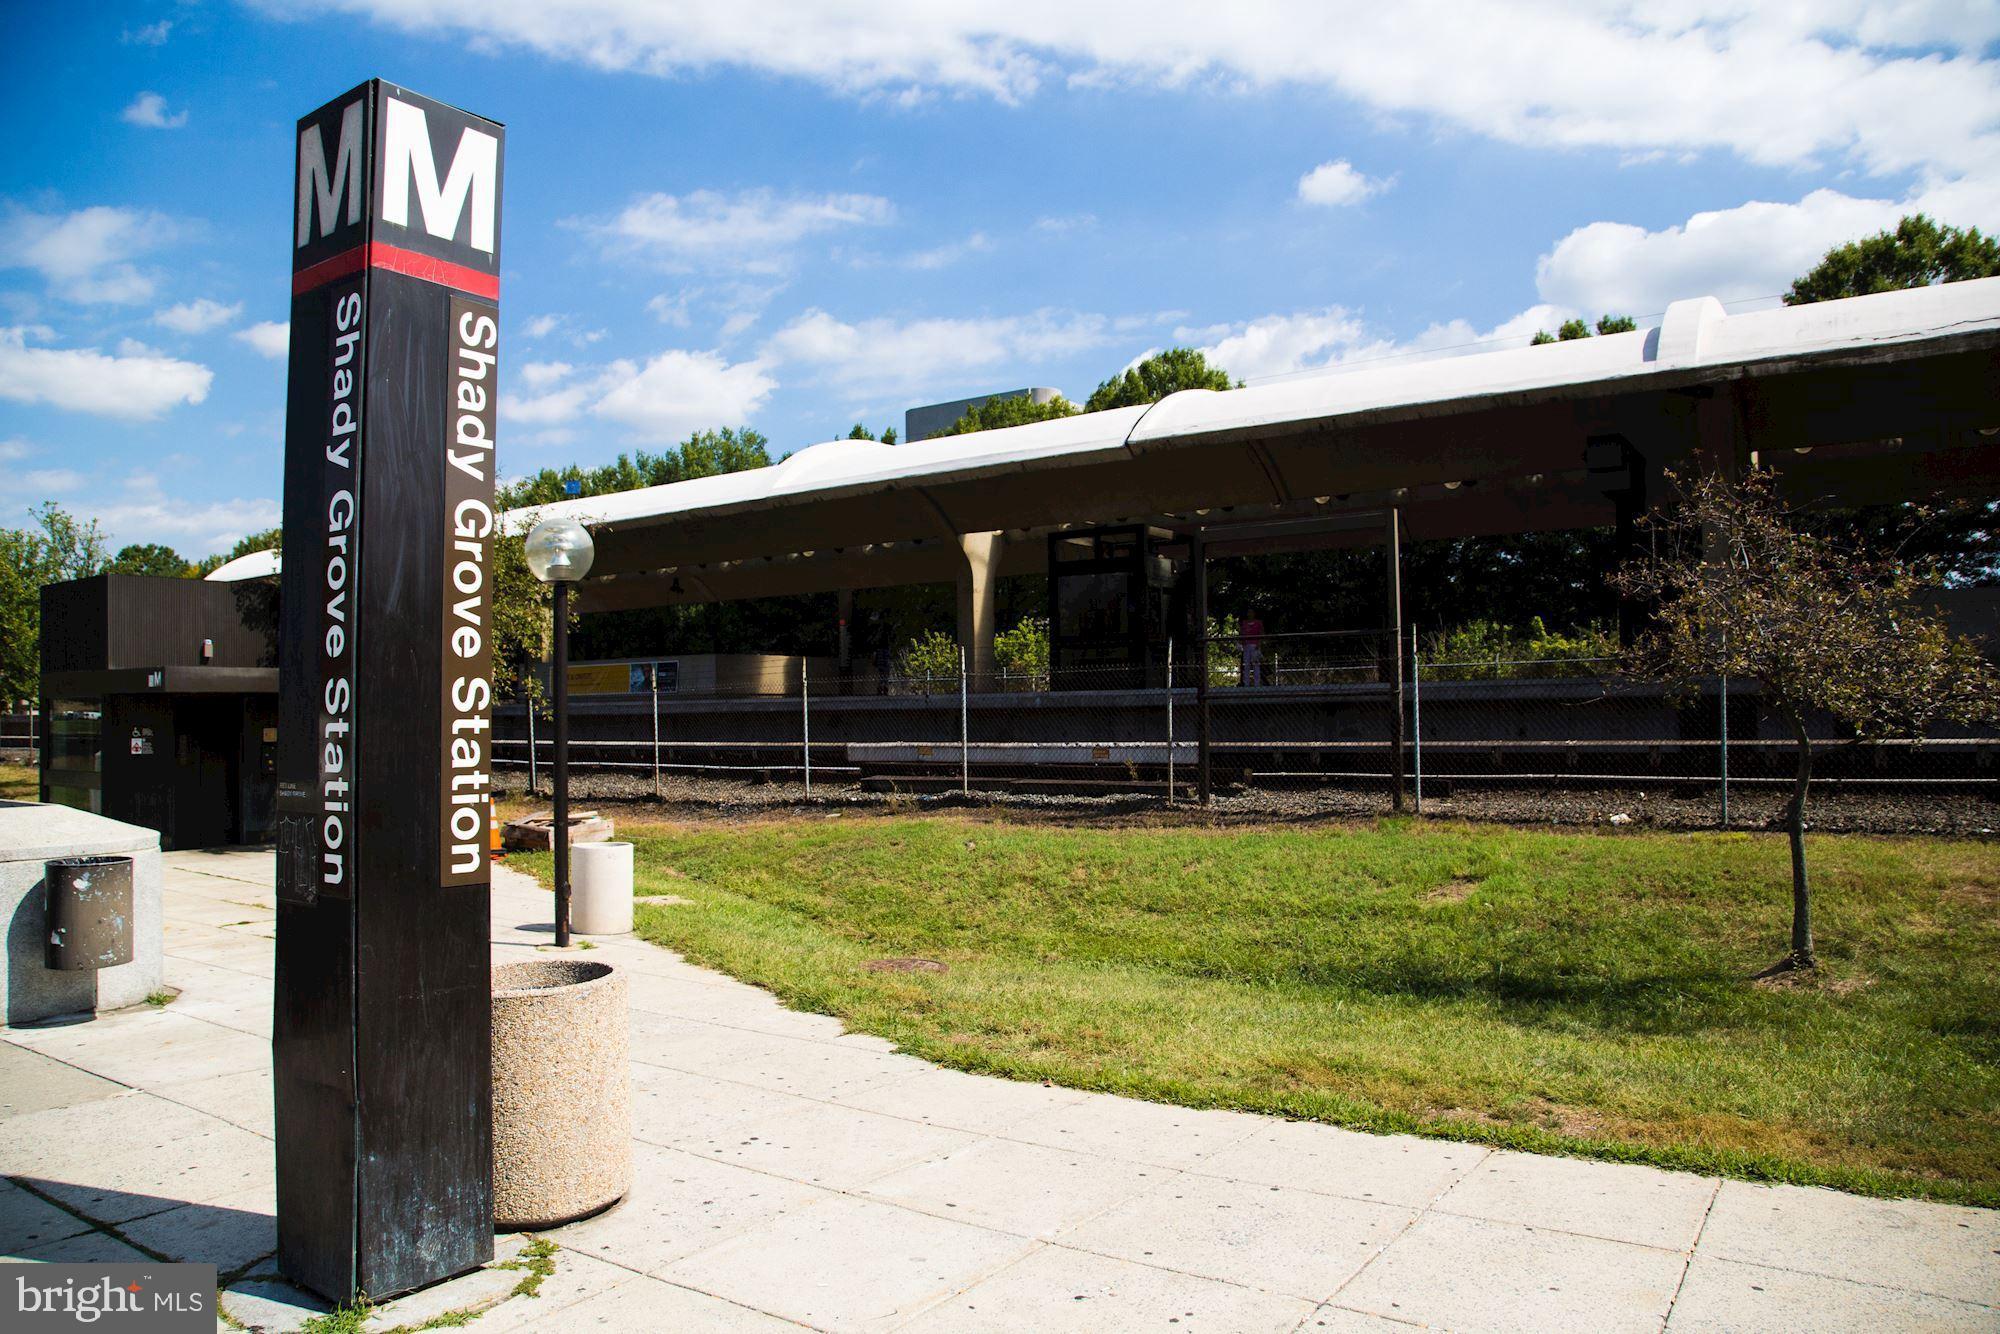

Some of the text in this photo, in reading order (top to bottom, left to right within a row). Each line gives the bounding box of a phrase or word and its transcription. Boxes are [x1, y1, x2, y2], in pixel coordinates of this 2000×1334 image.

[297, 98, 364, 249] M
[381, 96, 498, 255] M
[323, 292, 363, 885] Shady Grove Station
[447, 311, 498, 875] Shady Grove Station
